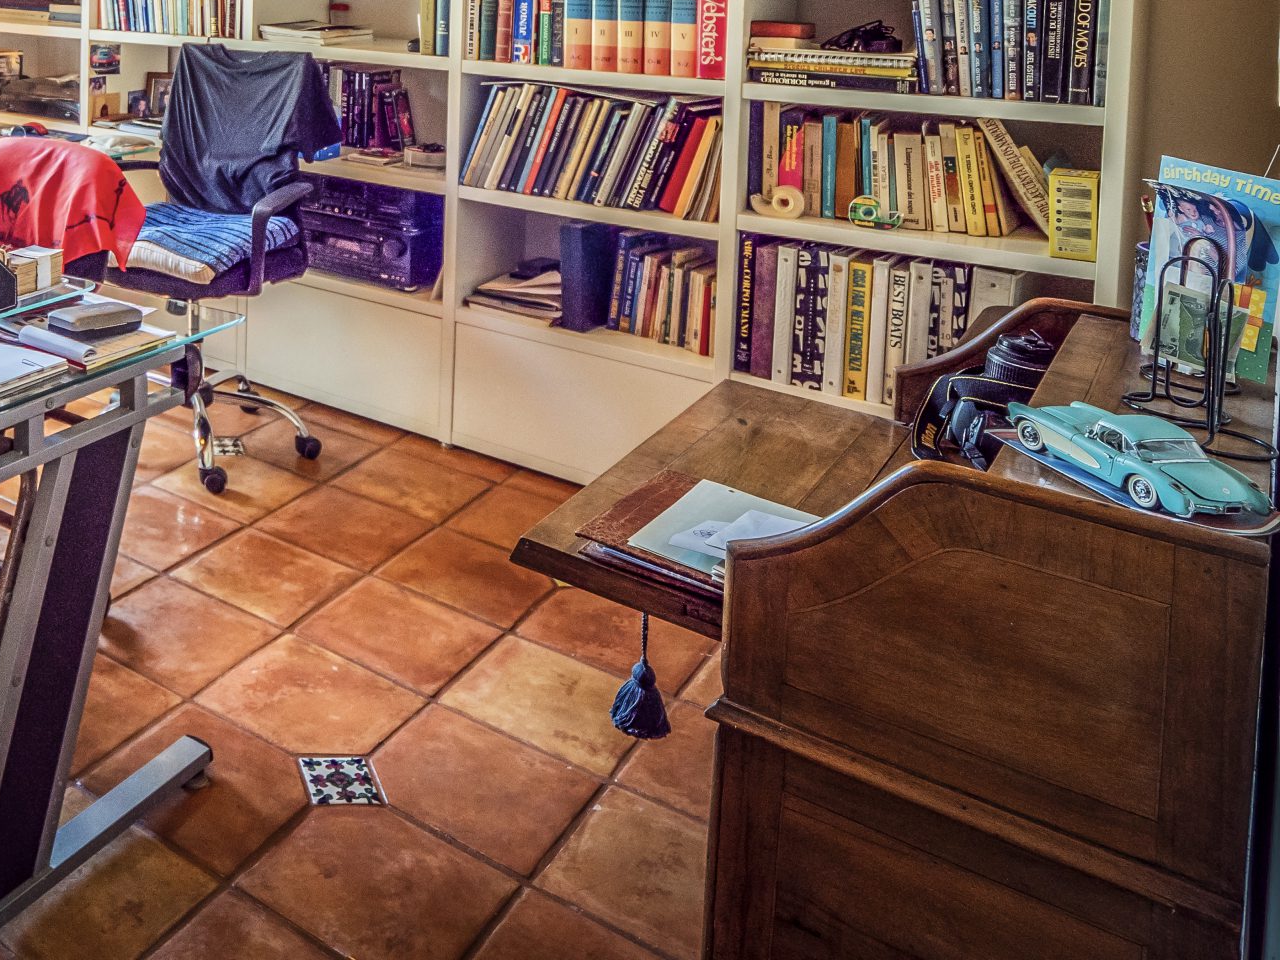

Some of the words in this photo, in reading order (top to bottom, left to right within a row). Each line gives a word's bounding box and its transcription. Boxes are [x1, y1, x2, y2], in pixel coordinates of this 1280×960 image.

[519, 2, 528, 36] JUNIOR
[1049, 20, 1056, 29] DU
[1077, 14, 1090, 29] OF
[1048, 31, 1056, 59] HISTOIRE
[1074, 31, 1089, 68] MOVIES
[1026, 51, 1035, 65] JOEL
[761, 76, 807, 86] BORROMEO
[807, 79, 830, 88] grande
[1026, 65, 1034, 86] OSTEEN
[1163, 165, 1231, 189] Birthday
[1235, 179, 1280, 205] Time
[633, 187, 646, 208] DELLA
[743, 241, 752, 259] ABC
[742, 268, 752, 302] CORPO
[852, 269, 866, 288] COSA
[851, 289, 866, 308] FARE
[892, 274, 906, 308] BEST
[740, 303, 750, 338] UMANO
[890, 310, 904, 349] BOATS
[848, 310, 864, 372] NELL'EMERGENZA
